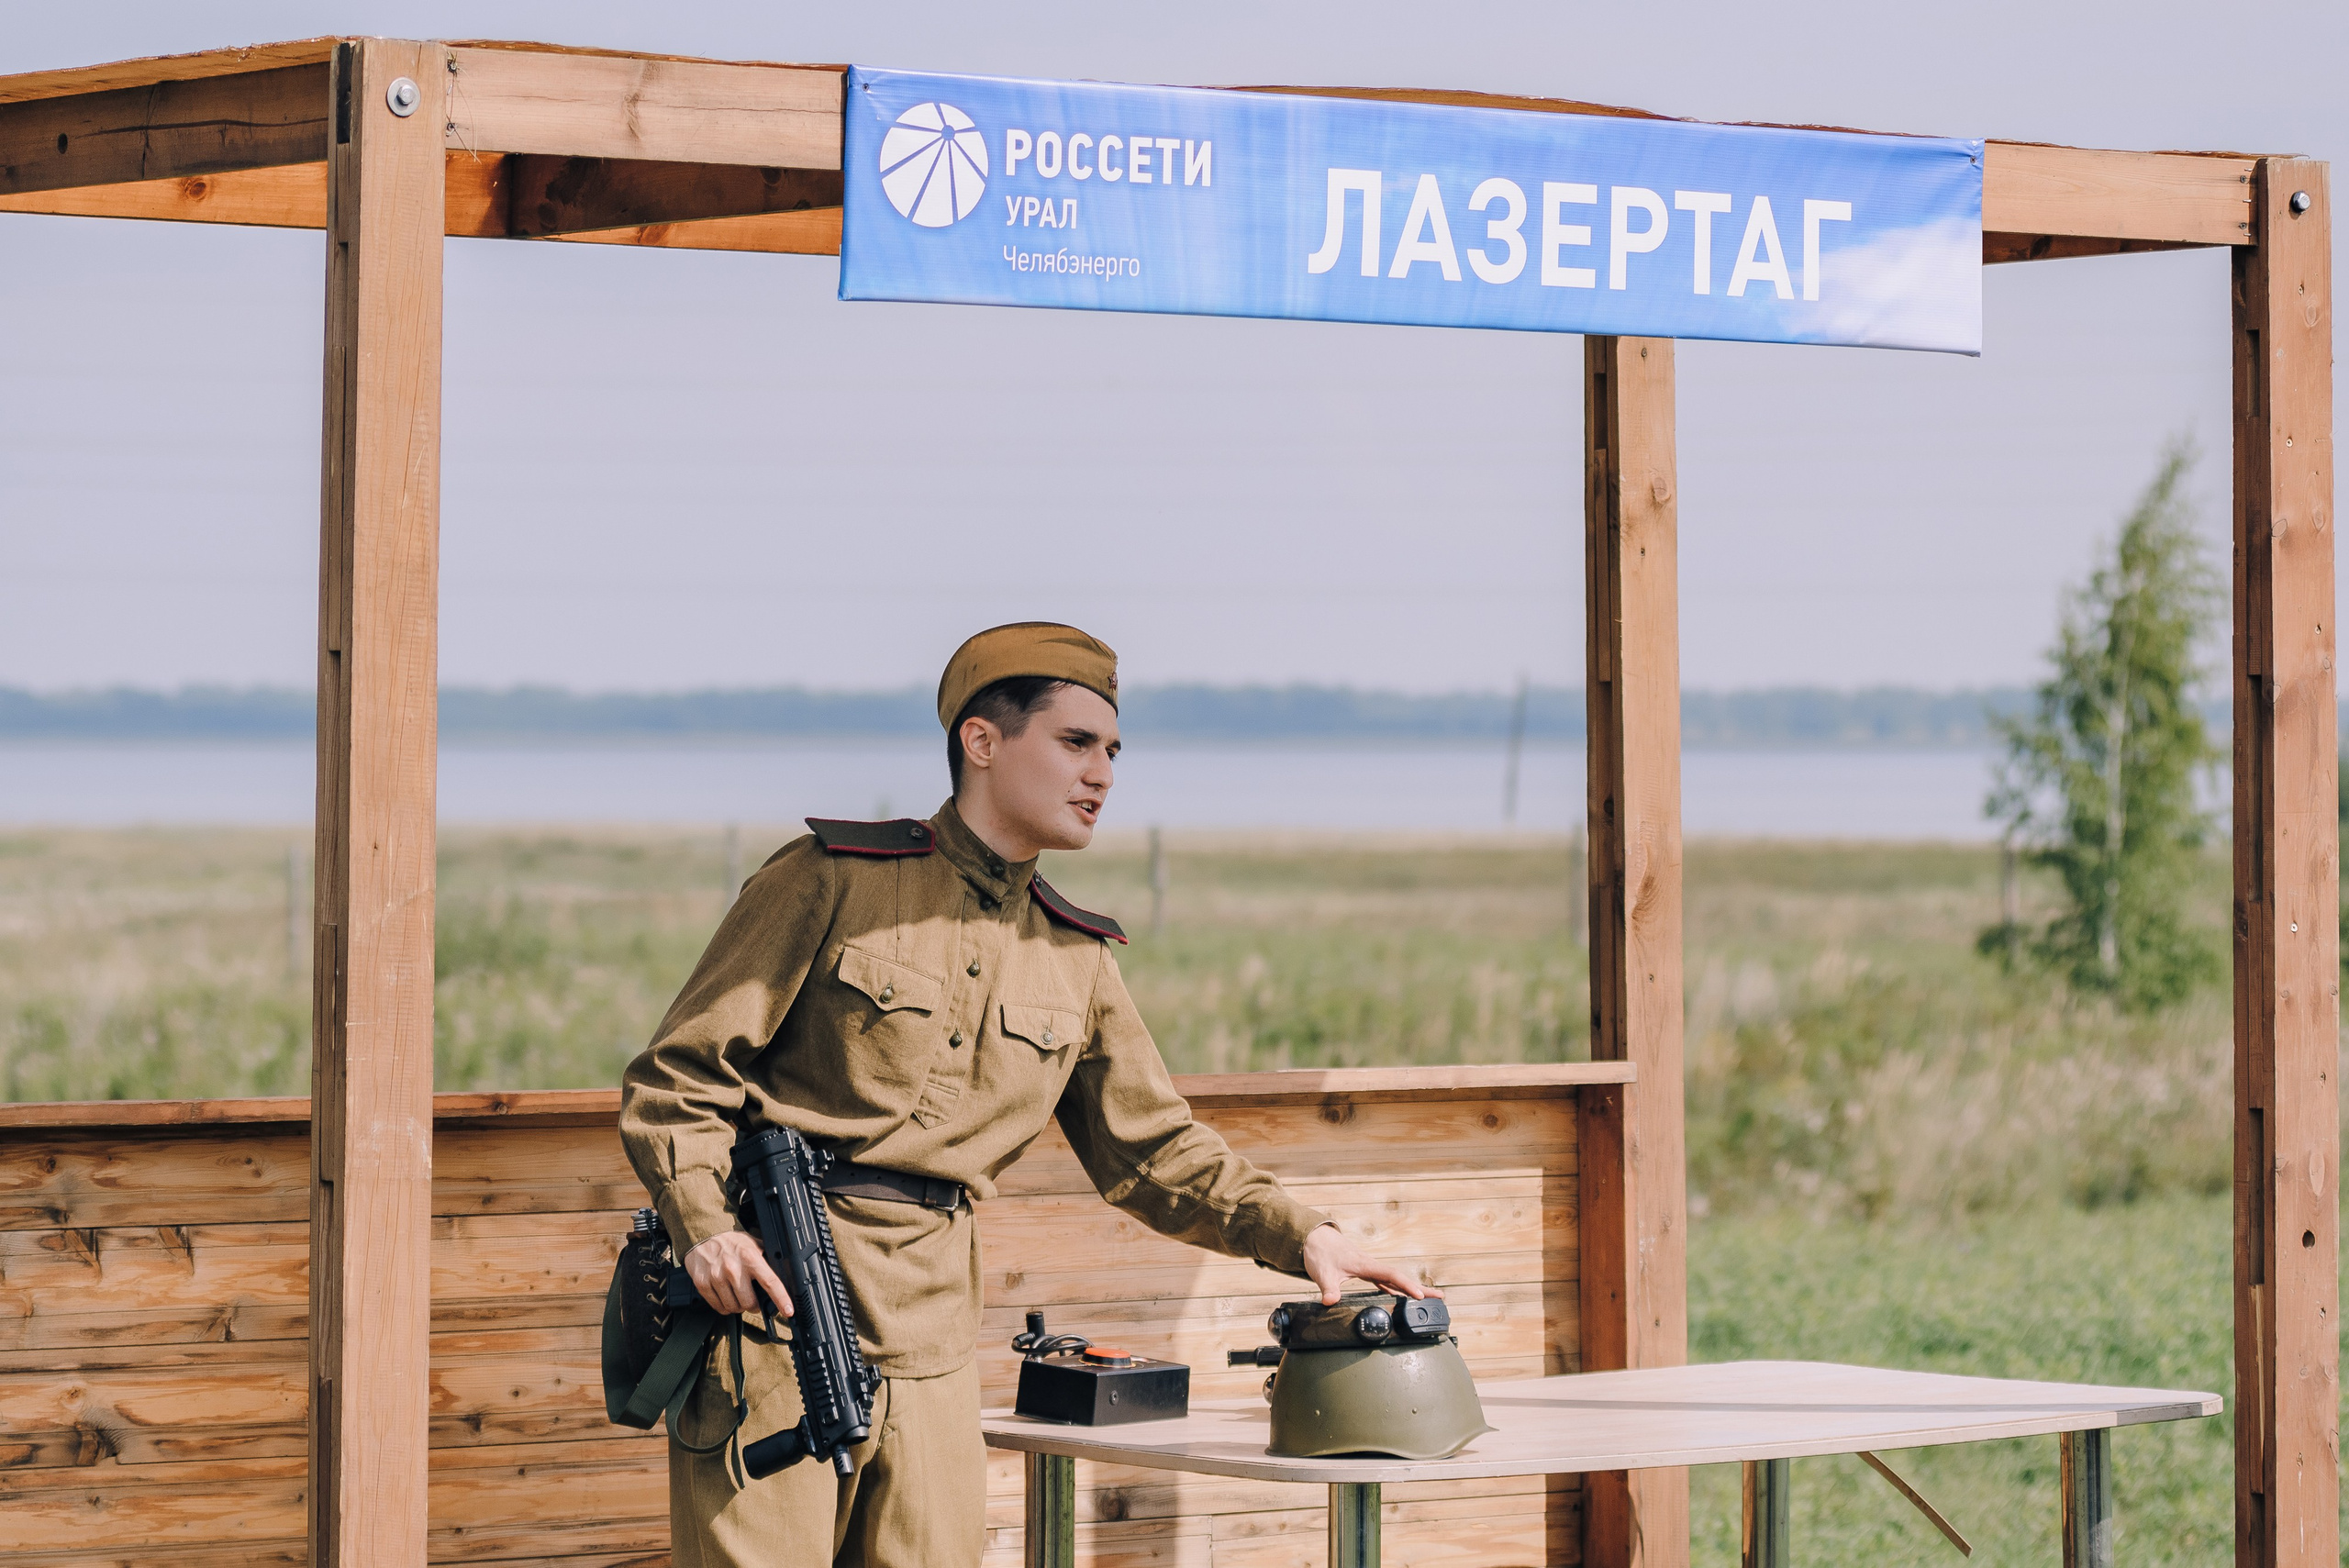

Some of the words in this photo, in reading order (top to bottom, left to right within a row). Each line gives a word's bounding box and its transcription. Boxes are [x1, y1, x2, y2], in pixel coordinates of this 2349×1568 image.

[1006, 128, 1212, 187] РОССЕТИ
[1005, 195, 1077, 229] УРАЛ
[1308, 167, 1852, 302] ЛАЗЕРТАГ
[1003, 245, 1141, 283] Челябэнерго
